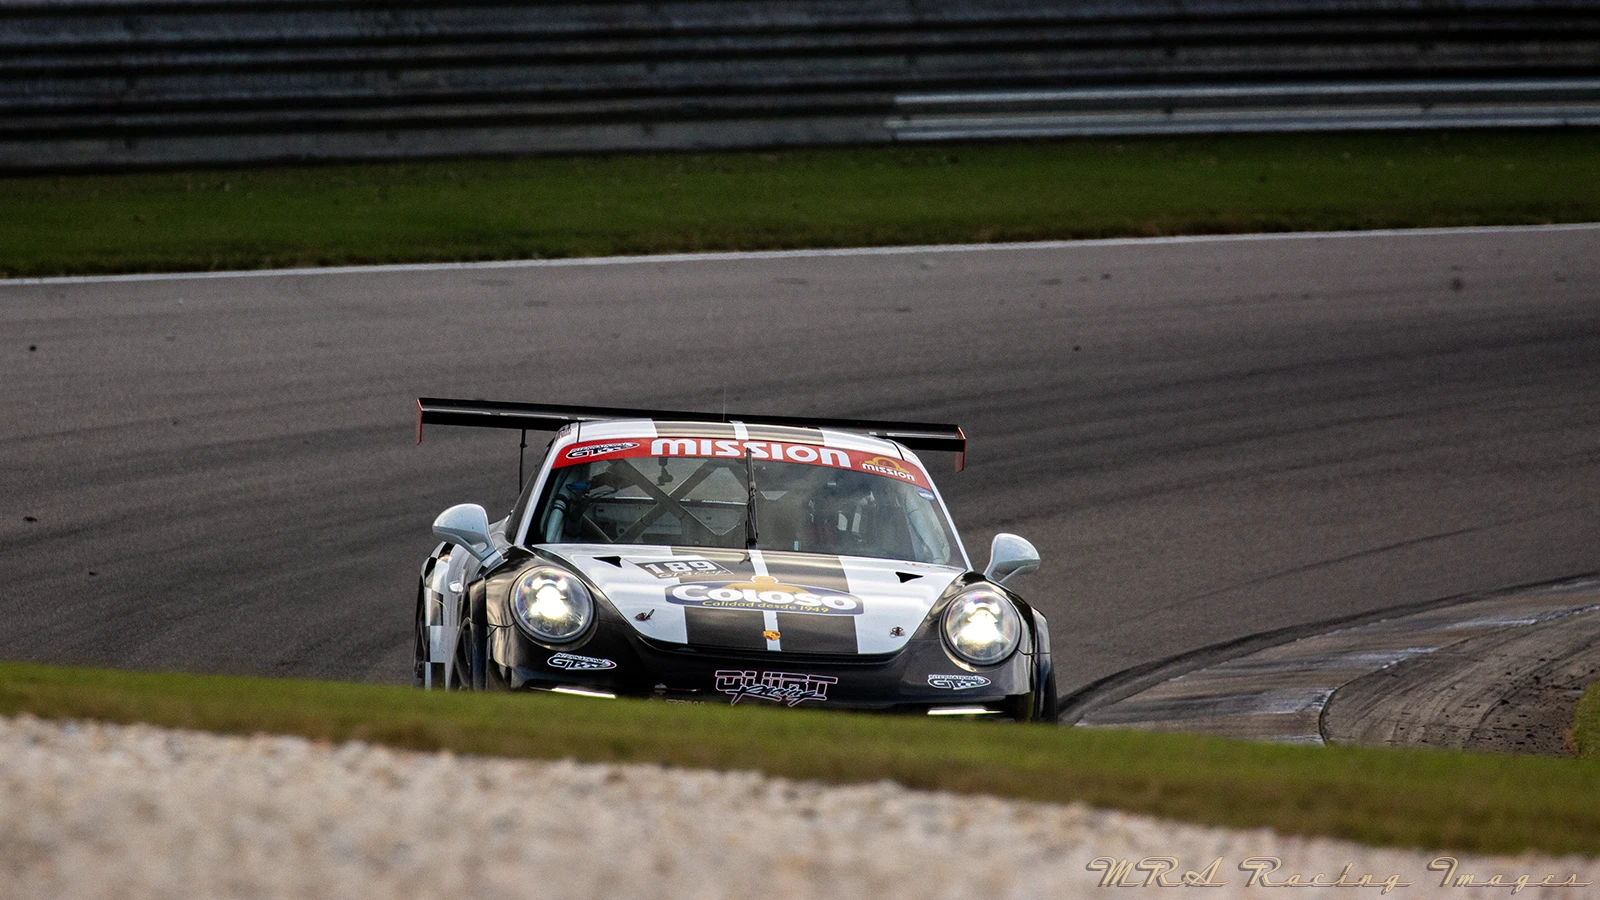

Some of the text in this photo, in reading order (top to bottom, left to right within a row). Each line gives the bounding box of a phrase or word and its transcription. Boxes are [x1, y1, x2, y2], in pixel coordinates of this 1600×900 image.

[645, 561, 717, 574] 189
[702, 600, 754, 608] Calidad
[800, 605, 829, 613] 1949
